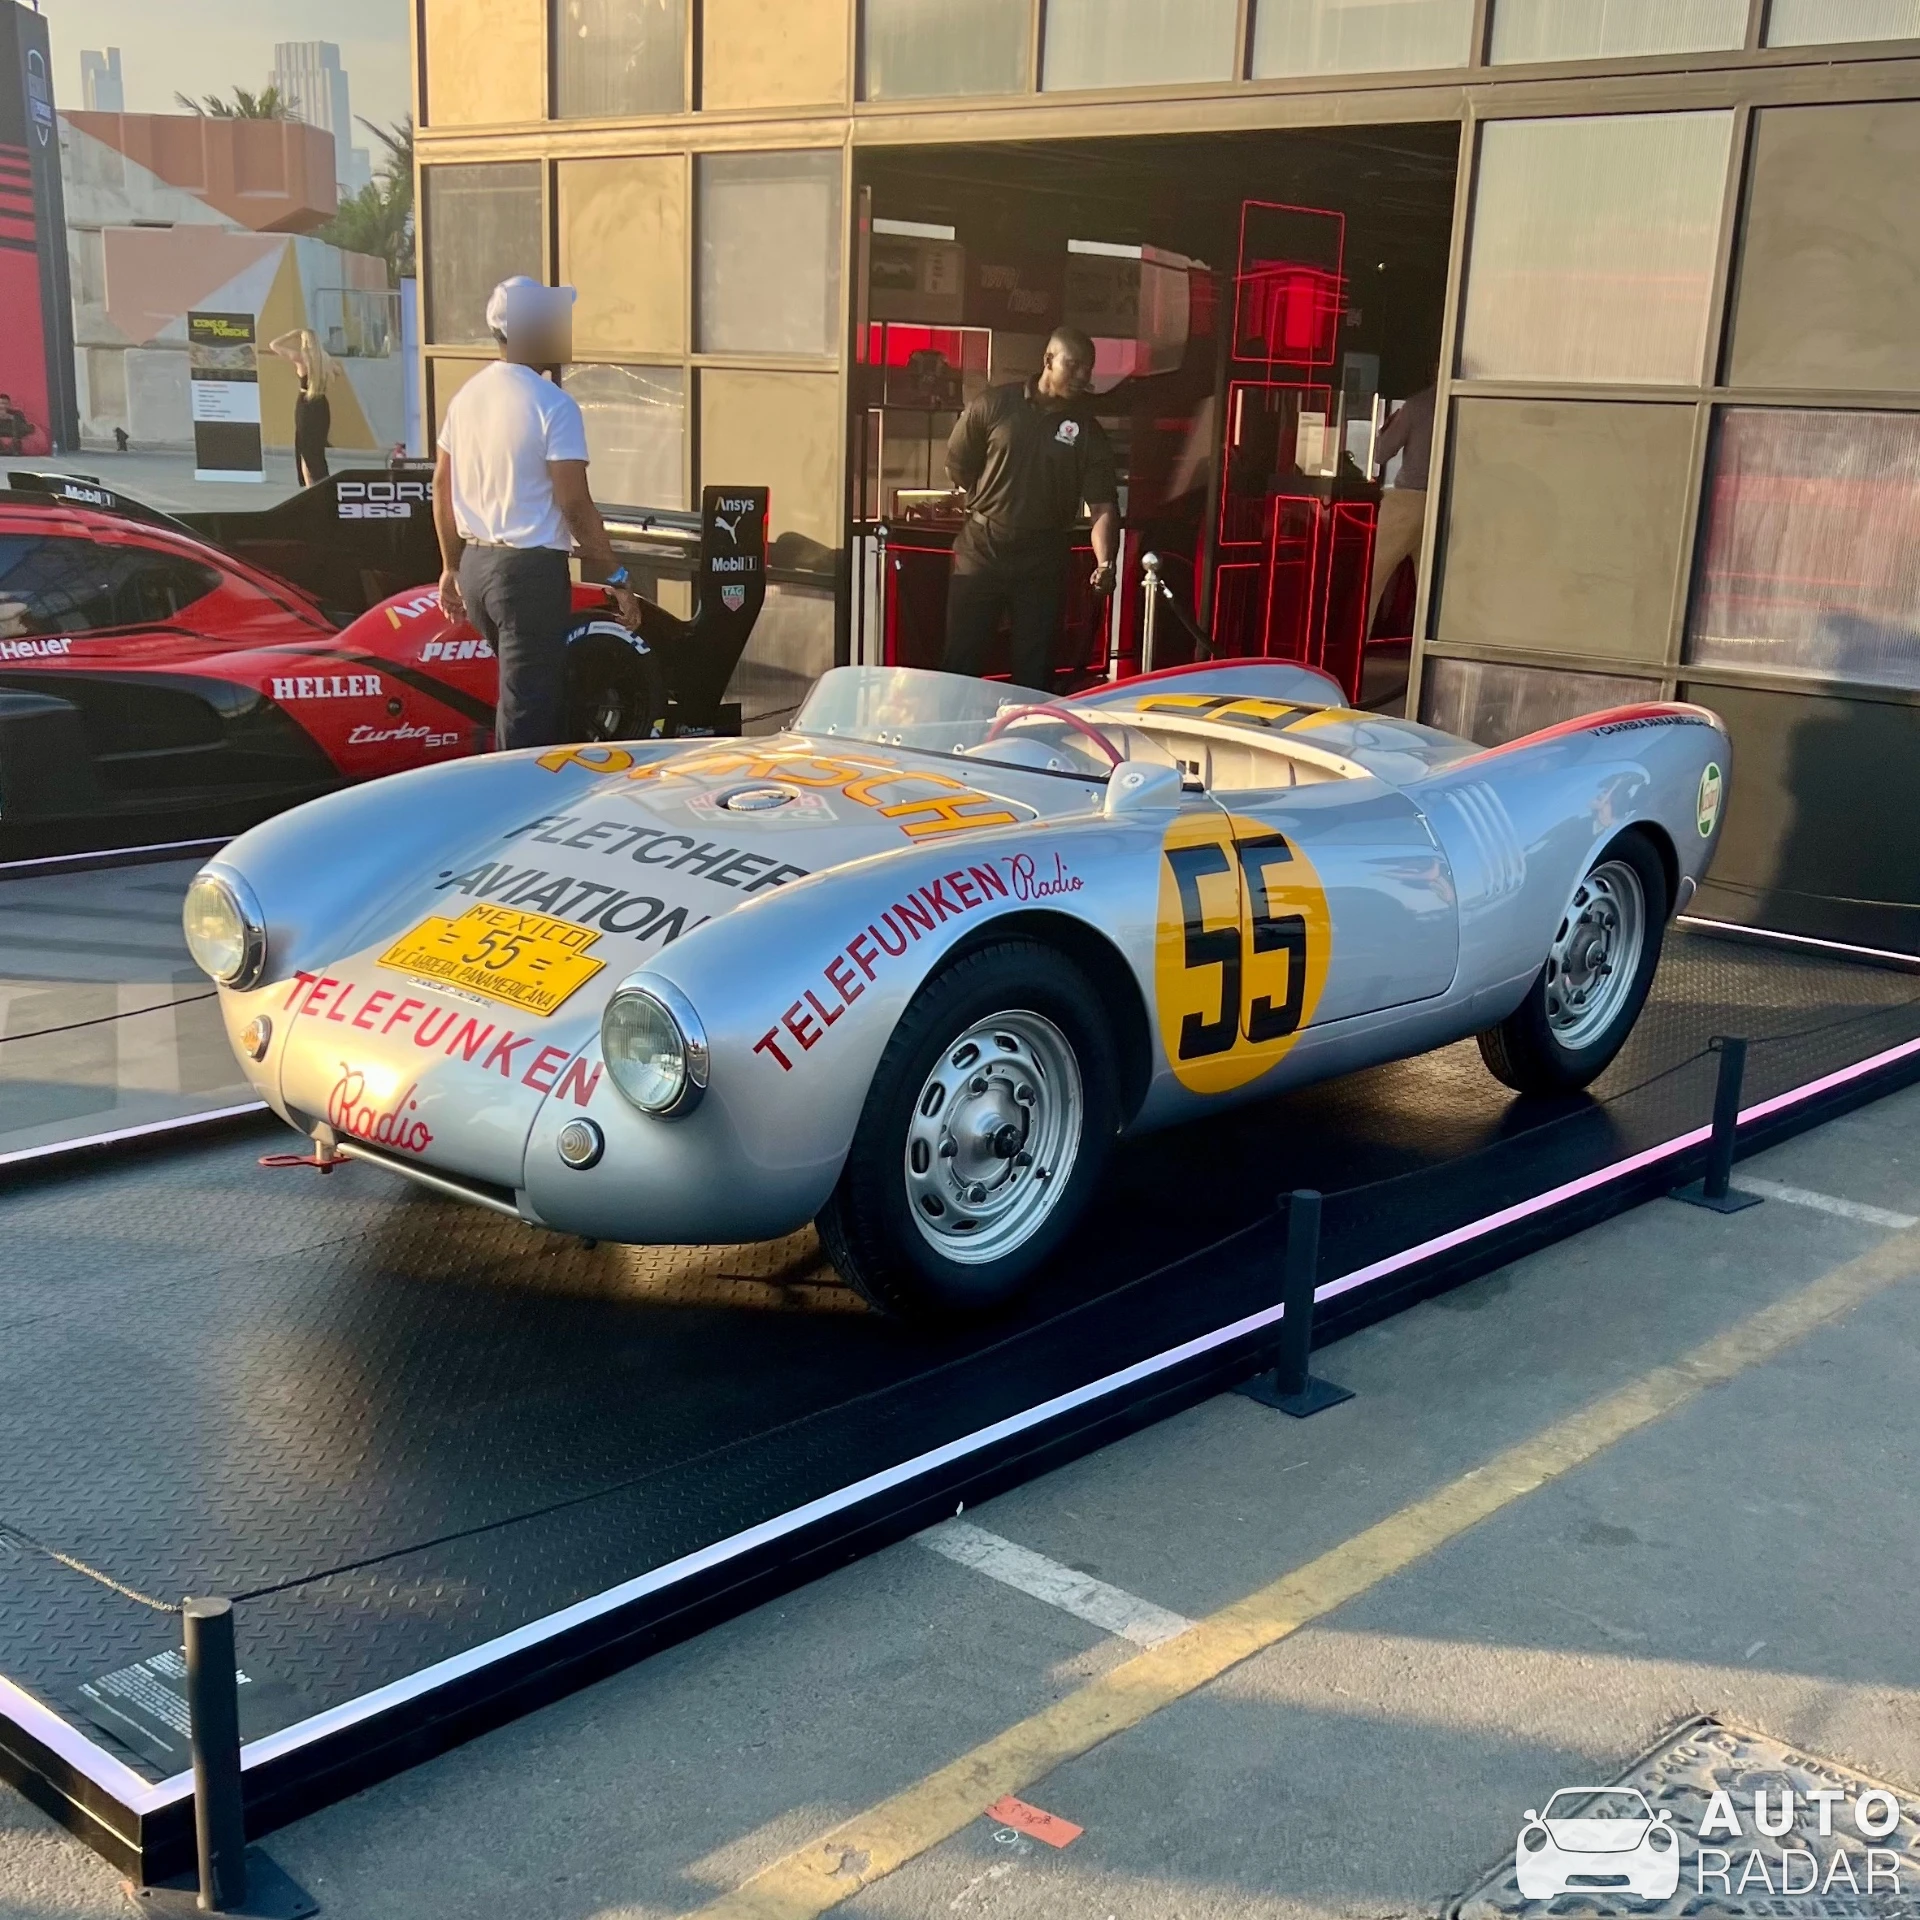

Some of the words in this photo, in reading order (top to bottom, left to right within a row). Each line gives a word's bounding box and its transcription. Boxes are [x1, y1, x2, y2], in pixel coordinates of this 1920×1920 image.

[64, 484, 101, 504] Mobil
[715, 496, 755, 514] Ansys
[338, 503, 412, 518] 963
[712, 557, 744, 572] Mobil
[724, 588, 742, 596] TAG
[417, 640, 498, 663] PENS
[271, 675, 383, 699] HELLER
[348, 722, 431, 744] turbo
[434, 862, 712, 946] AVIATION
[466, 906, 588, 948] MEXICO
[462, 929, 536, 970] 55
[752, 863, 1009, 1072] TELEFUNKEN
[1001, 852, 1085, 901] Radio
[1164, 833, 1308, 1060] 55
[388, 947, 406, 962] V
[402, 951, 459, 977] CARRERA
[456, 966, 558, 1009] PANAMERICANA
[283, 970, 605, 1107] TELEFUNKEN
[328, 1061, 434, 1153] Radio
